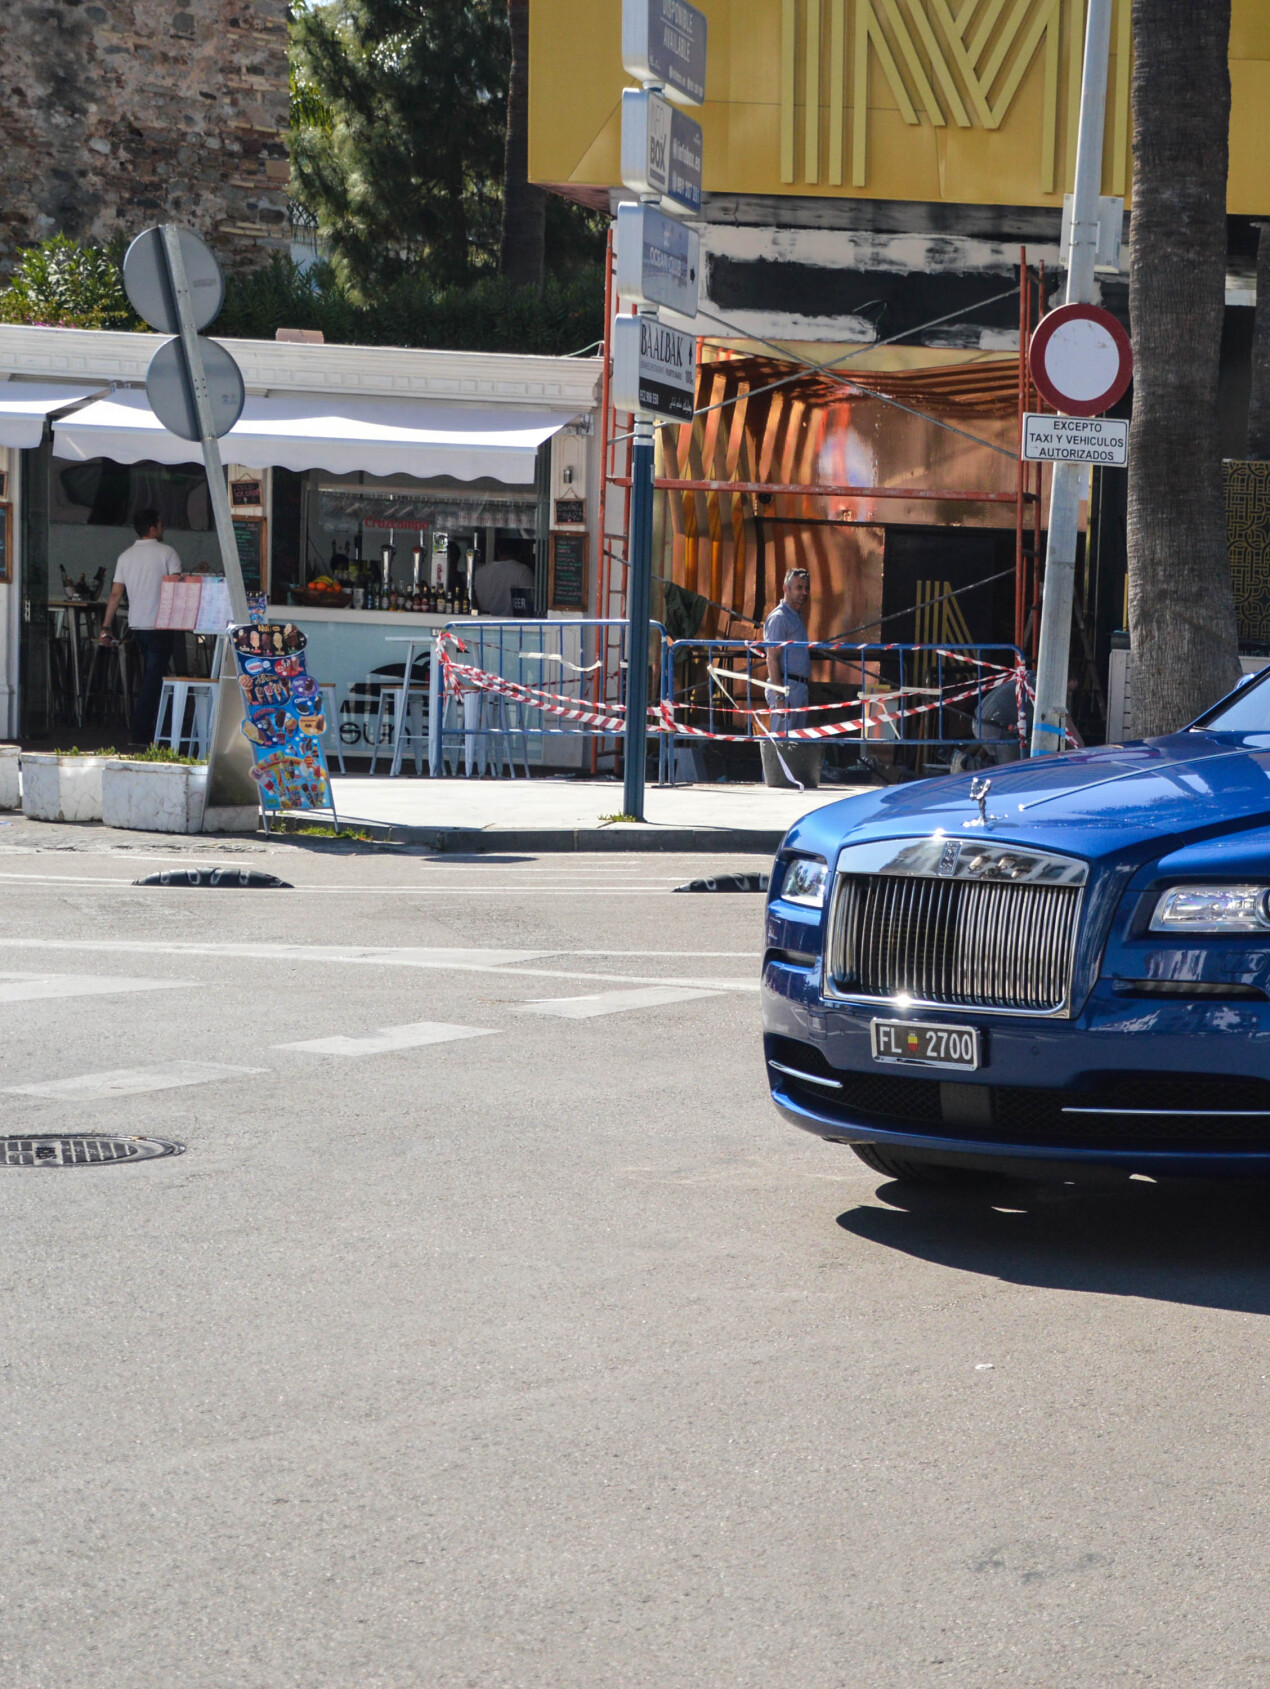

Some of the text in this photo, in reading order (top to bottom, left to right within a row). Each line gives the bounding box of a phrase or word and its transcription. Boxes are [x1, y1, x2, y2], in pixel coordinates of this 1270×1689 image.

[649, 134, 667, 173] BOX
[641, 323, 683, 367] BAALBAK
[1053, 420, 1102, 433] EXCEPTO
[1029, 432, 1124, 448] TAXI Y VEHICULOS
[1039, 447, 1114, 461] AUTORIZADOS
[364, 515, 430, 532] Cruzcampo
[879, 1026, 972, 1060] FL 2700
